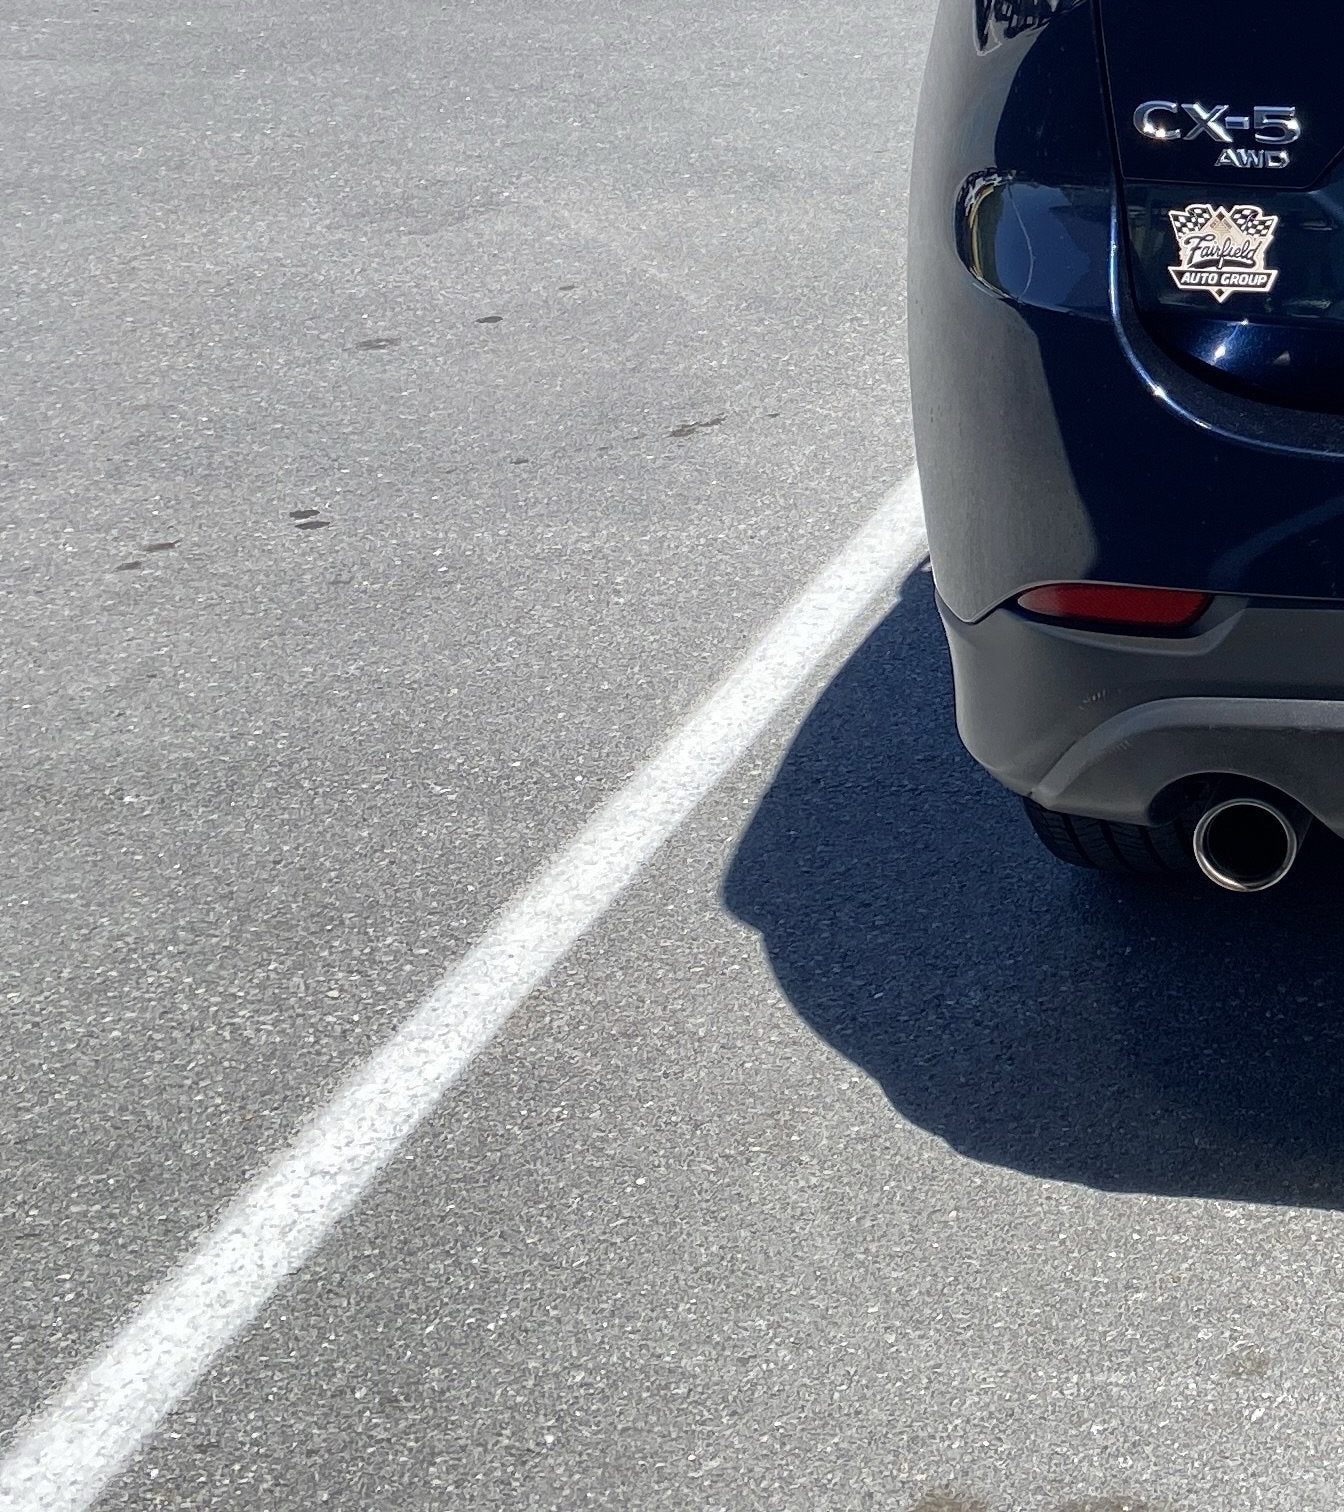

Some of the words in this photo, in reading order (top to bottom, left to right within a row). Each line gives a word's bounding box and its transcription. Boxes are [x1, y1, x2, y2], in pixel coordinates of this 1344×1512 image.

[1133, 100, 1301, 144] CX-5
[1214, 149, 1290, 168] AWD
[1184, 234, 1262, 266] Fairfield
[1181, 272, 1218, 284] AUTO
[1220, 273, 1268, 286] GROUP
